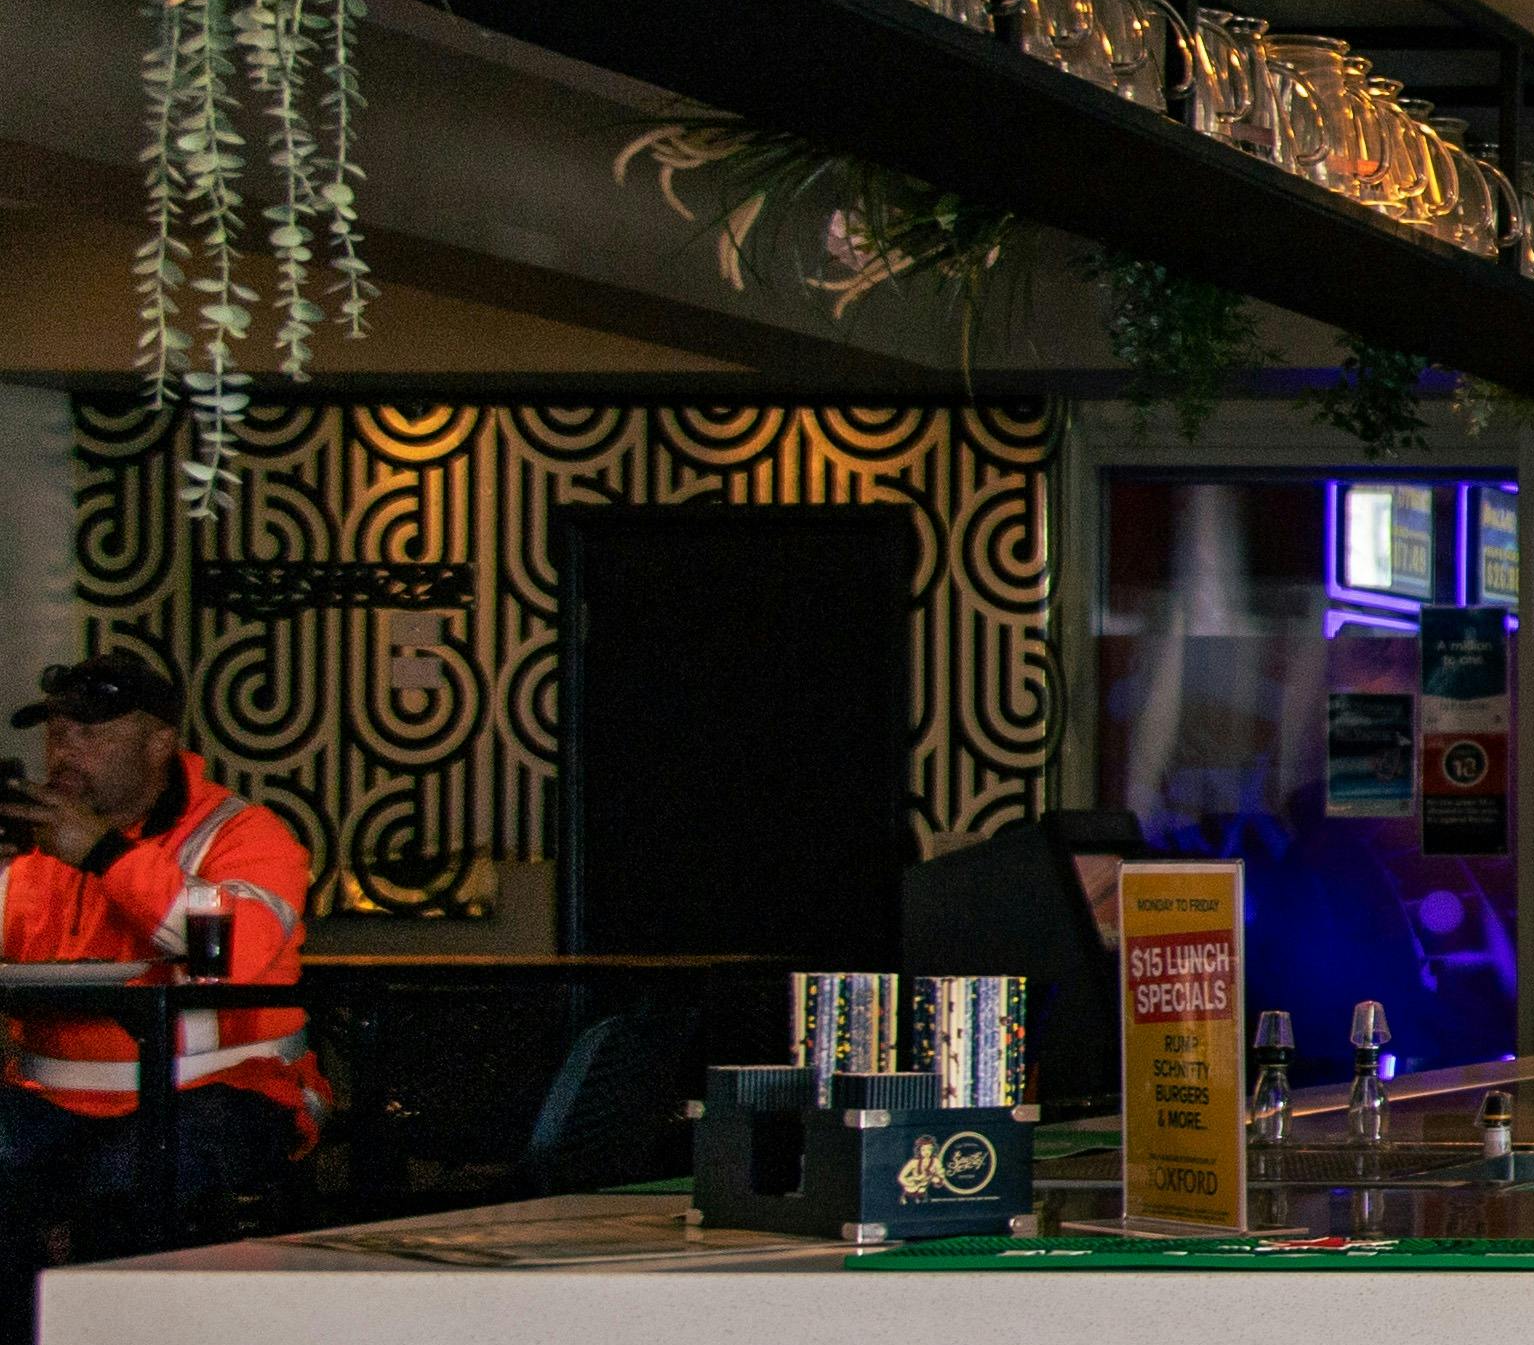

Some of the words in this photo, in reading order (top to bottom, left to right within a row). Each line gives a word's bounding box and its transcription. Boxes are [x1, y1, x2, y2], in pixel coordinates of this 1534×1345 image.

[1189, 898, 1220, 912] FRIDAY
[1131, 946, 1163, 980] $15
[1166, 942, 1230, 976] LUNCH
[1137, 979, 1228, 1014] SPECIALS
[1155, 1084, 1210, 1105] BURGERS
[1154, 1166, 1218, 1195] OXFORD
